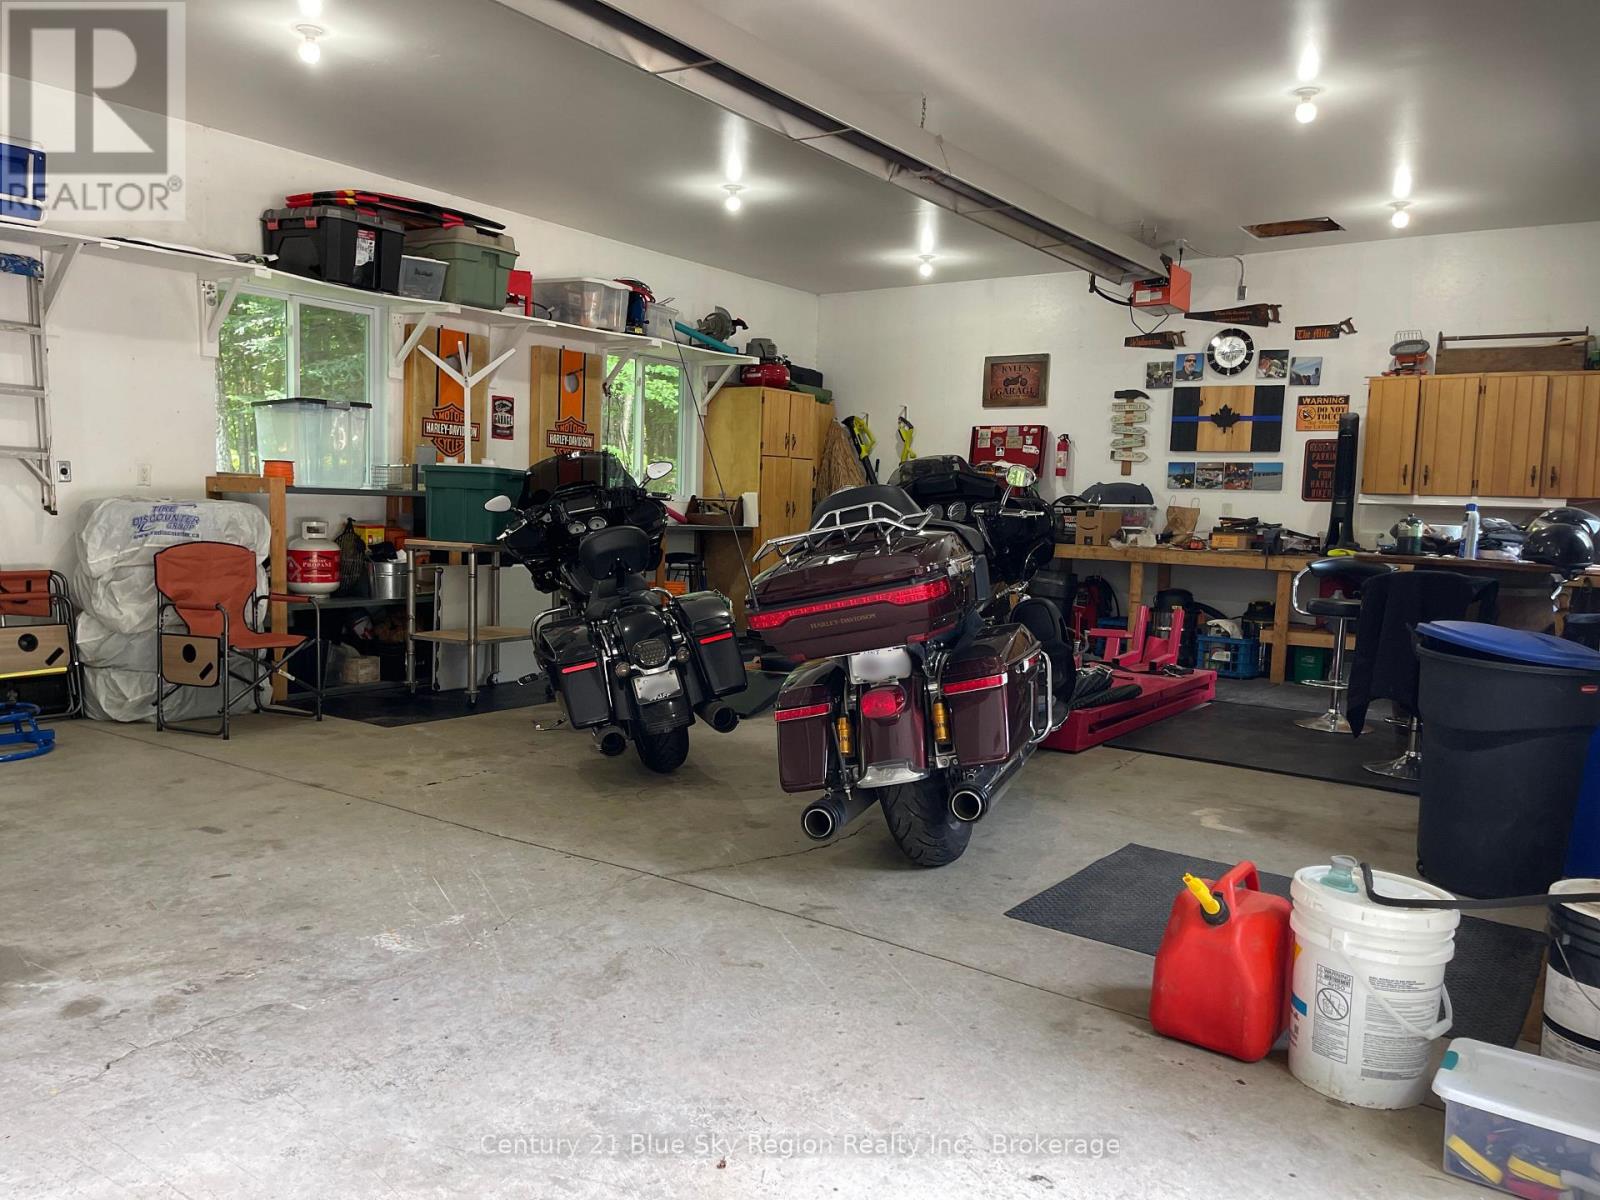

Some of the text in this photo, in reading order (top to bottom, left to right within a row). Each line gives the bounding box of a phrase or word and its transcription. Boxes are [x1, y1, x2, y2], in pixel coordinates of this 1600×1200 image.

[1302, 397, 1345, 405] WARNING
[549, 433, 592, 448] HARLEY-DAVIDSON
[132, 513, 200, 527] DISCOUNTER
[810, 614, 876, 629] HARLEY-DAVIDSON
